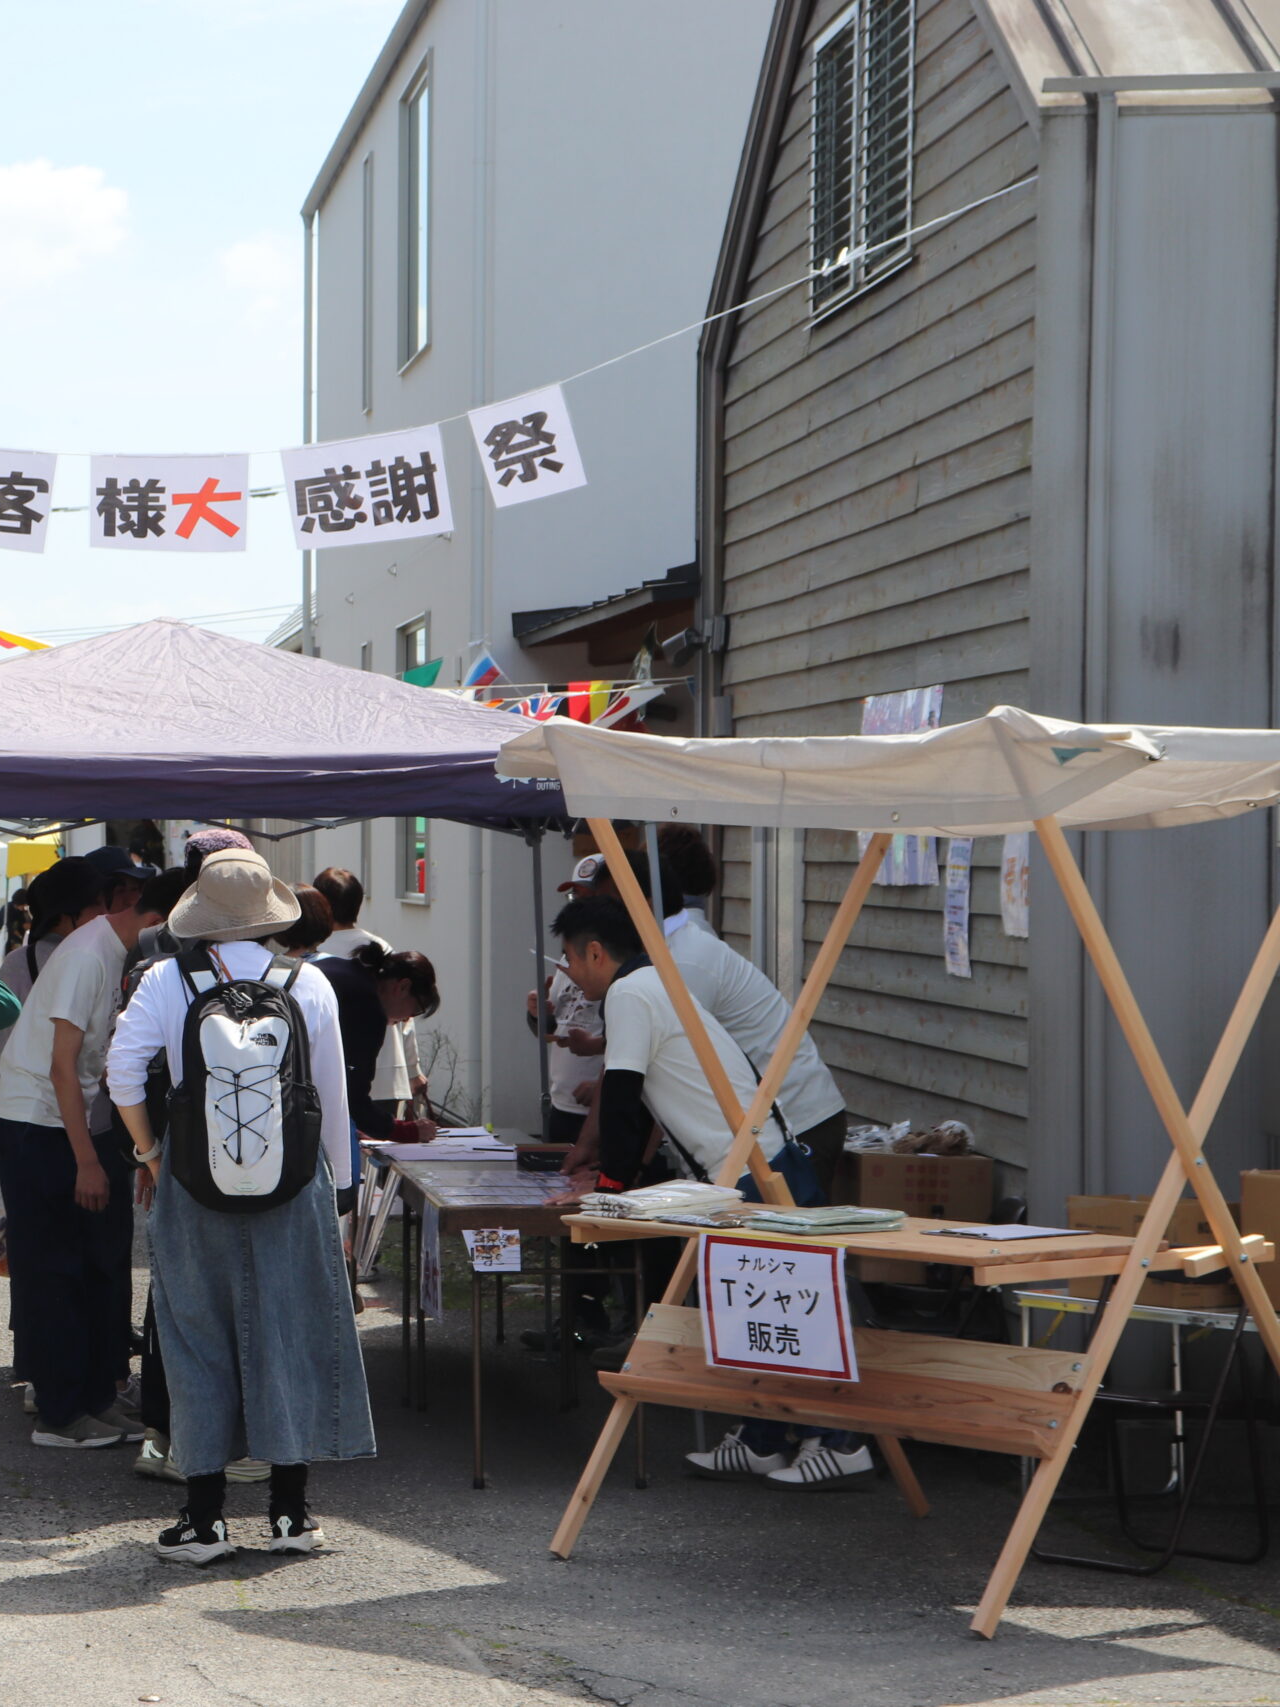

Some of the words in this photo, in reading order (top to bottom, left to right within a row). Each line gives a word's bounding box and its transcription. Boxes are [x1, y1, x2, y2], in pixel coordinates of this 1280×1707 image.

[737, 1253, 796, 1276] ナルシマ
[720, 1278, 820, 1316] Tシャツ
[747, 1321, 801, 1357] 販売
